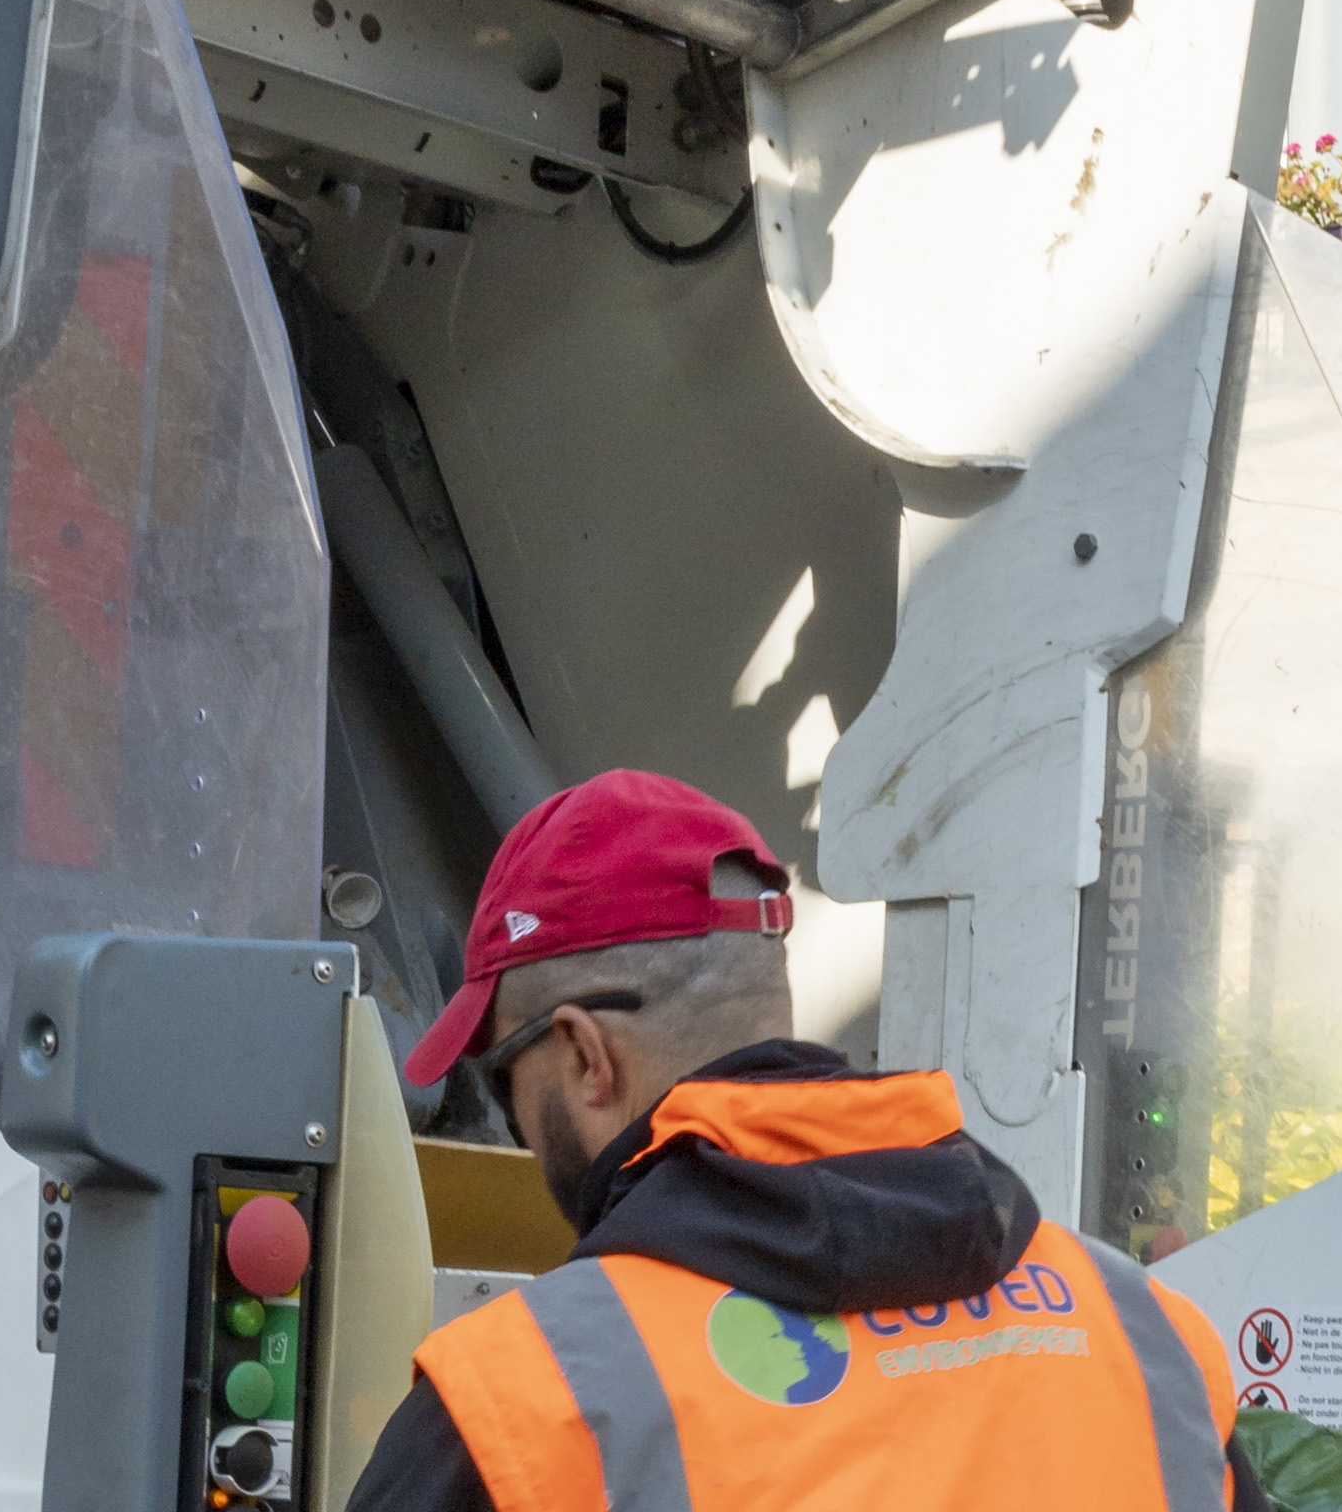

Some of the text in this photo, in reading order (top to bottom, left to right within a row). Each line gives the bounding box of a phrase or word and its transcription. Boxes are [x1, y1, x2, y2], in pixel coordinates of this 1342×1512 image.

[1303, 1315, 1324, 1325] Keep
[1302, 1327, 1319, 1337] Niet
[1320, 1329, 1329, 1337] in
[1330, 1329, 1341, 1338] de
[1302, 1340, 1313, 1349] Ne
[1314, 1342, 1329, 1351] pas
[1300, 1354, 1311, 1362] en
[1300, 1365, 1321, 1375] Nicht
[1324, 1367, 1331, 1375] in
[1299, 1395, 1310, 1405] Do
[1312, 1397, 1325, 1405] not
[1316, 1410, 1340, 1418] onder
